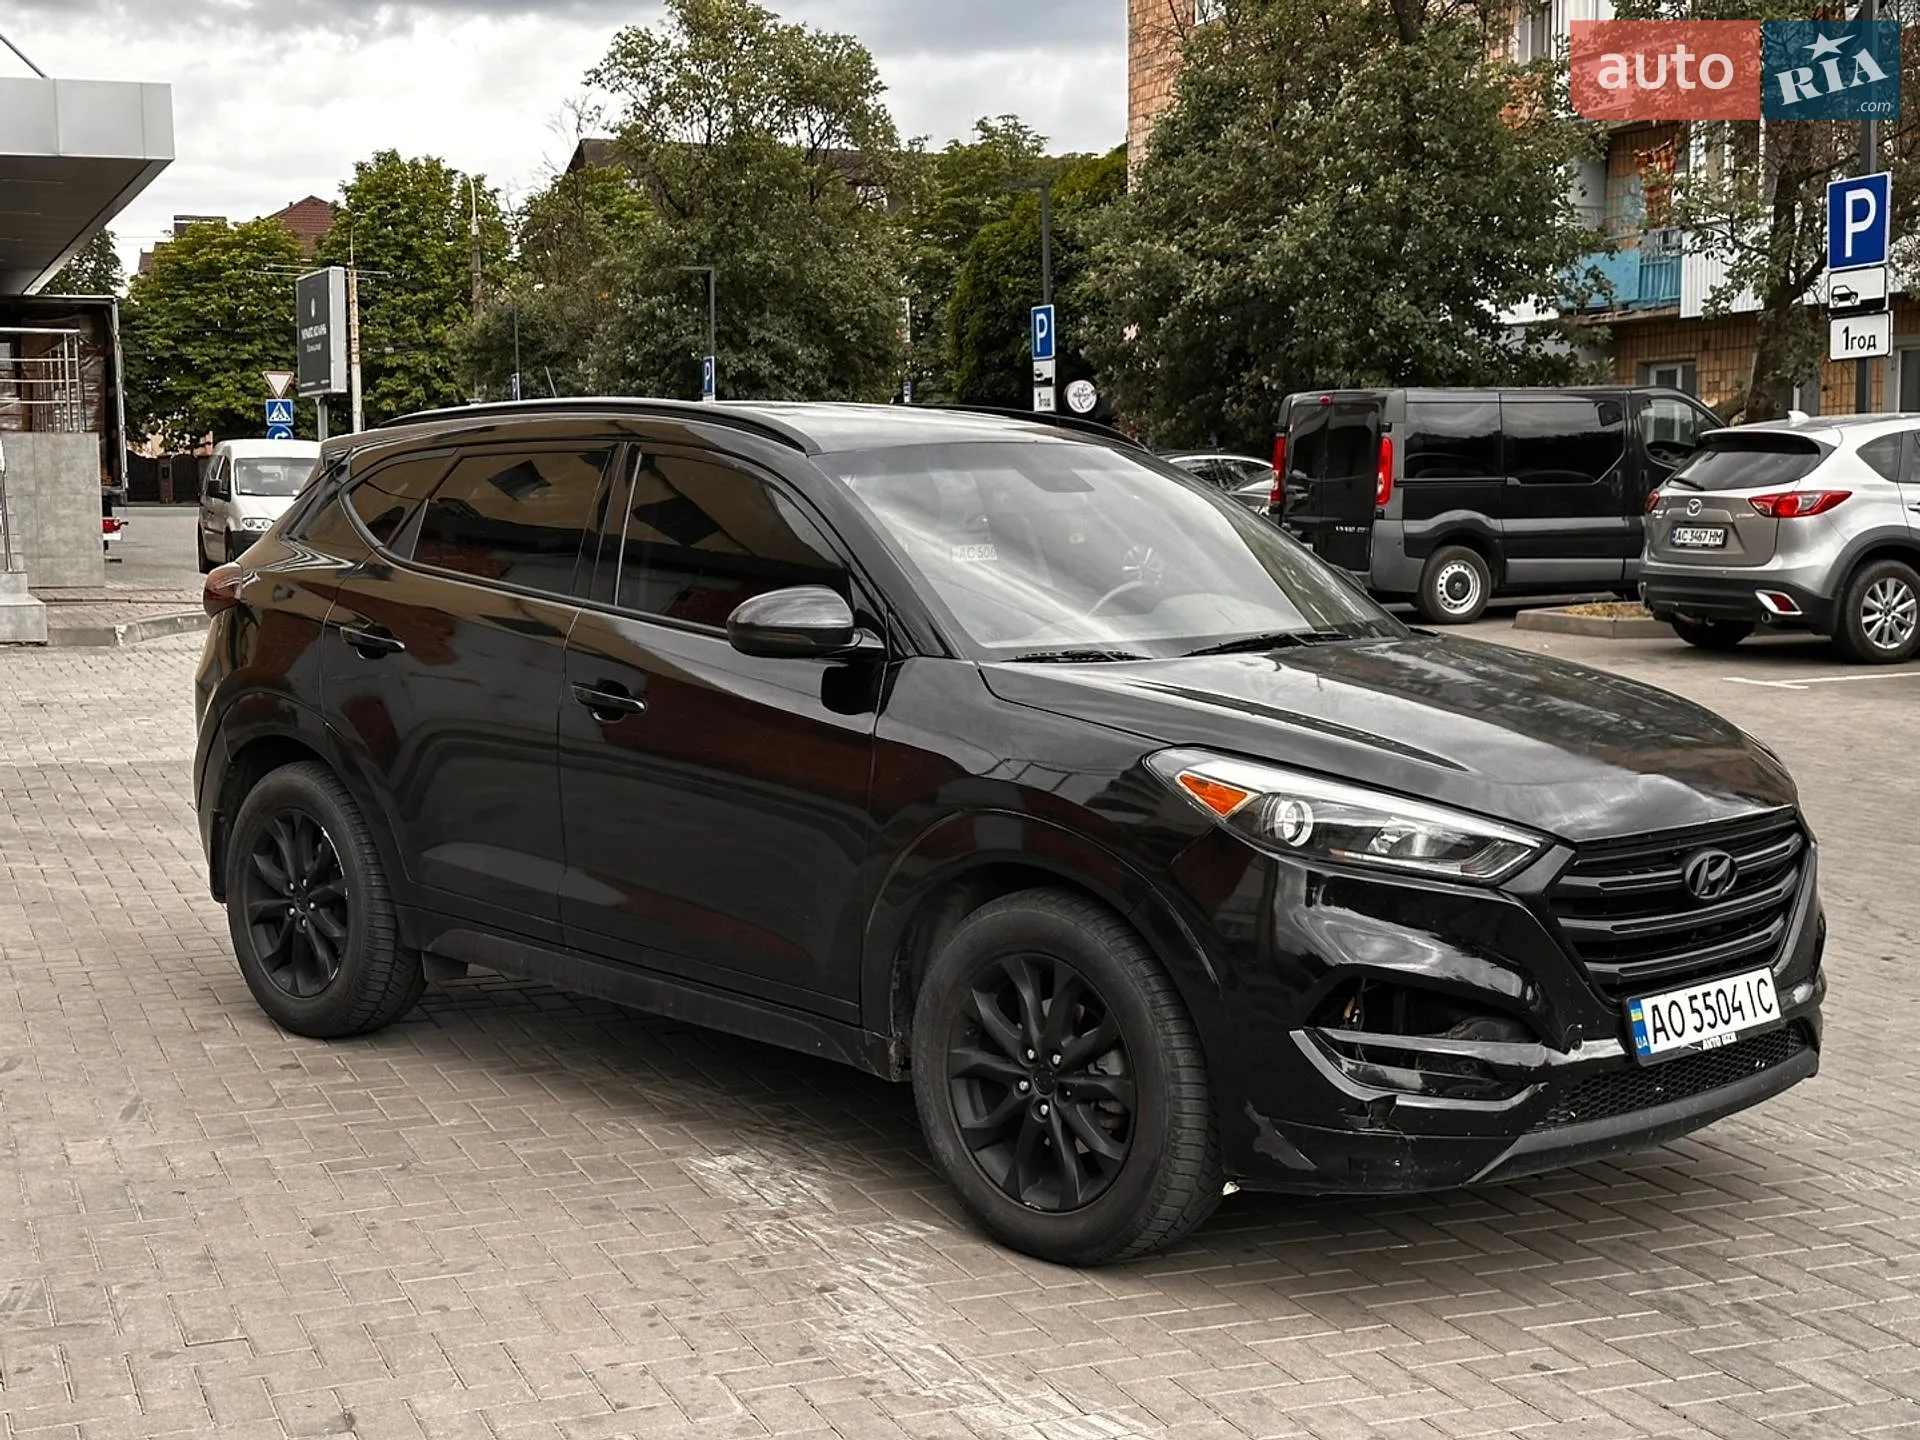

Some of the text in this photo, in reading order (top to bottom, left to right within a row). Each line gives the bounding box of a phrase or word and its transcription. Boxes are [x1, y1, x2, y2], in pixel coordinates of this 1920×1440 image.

[1845, 188, 1877, 258] P
[1035, 313, 1048, 353] P
[1635, 1035, 1648, 1049] UA
[1651, 1000, 1685, 1044] AO
[1688, 984, 1745, 1033] 5504
[1747, 978, 1773, 1018] IC
